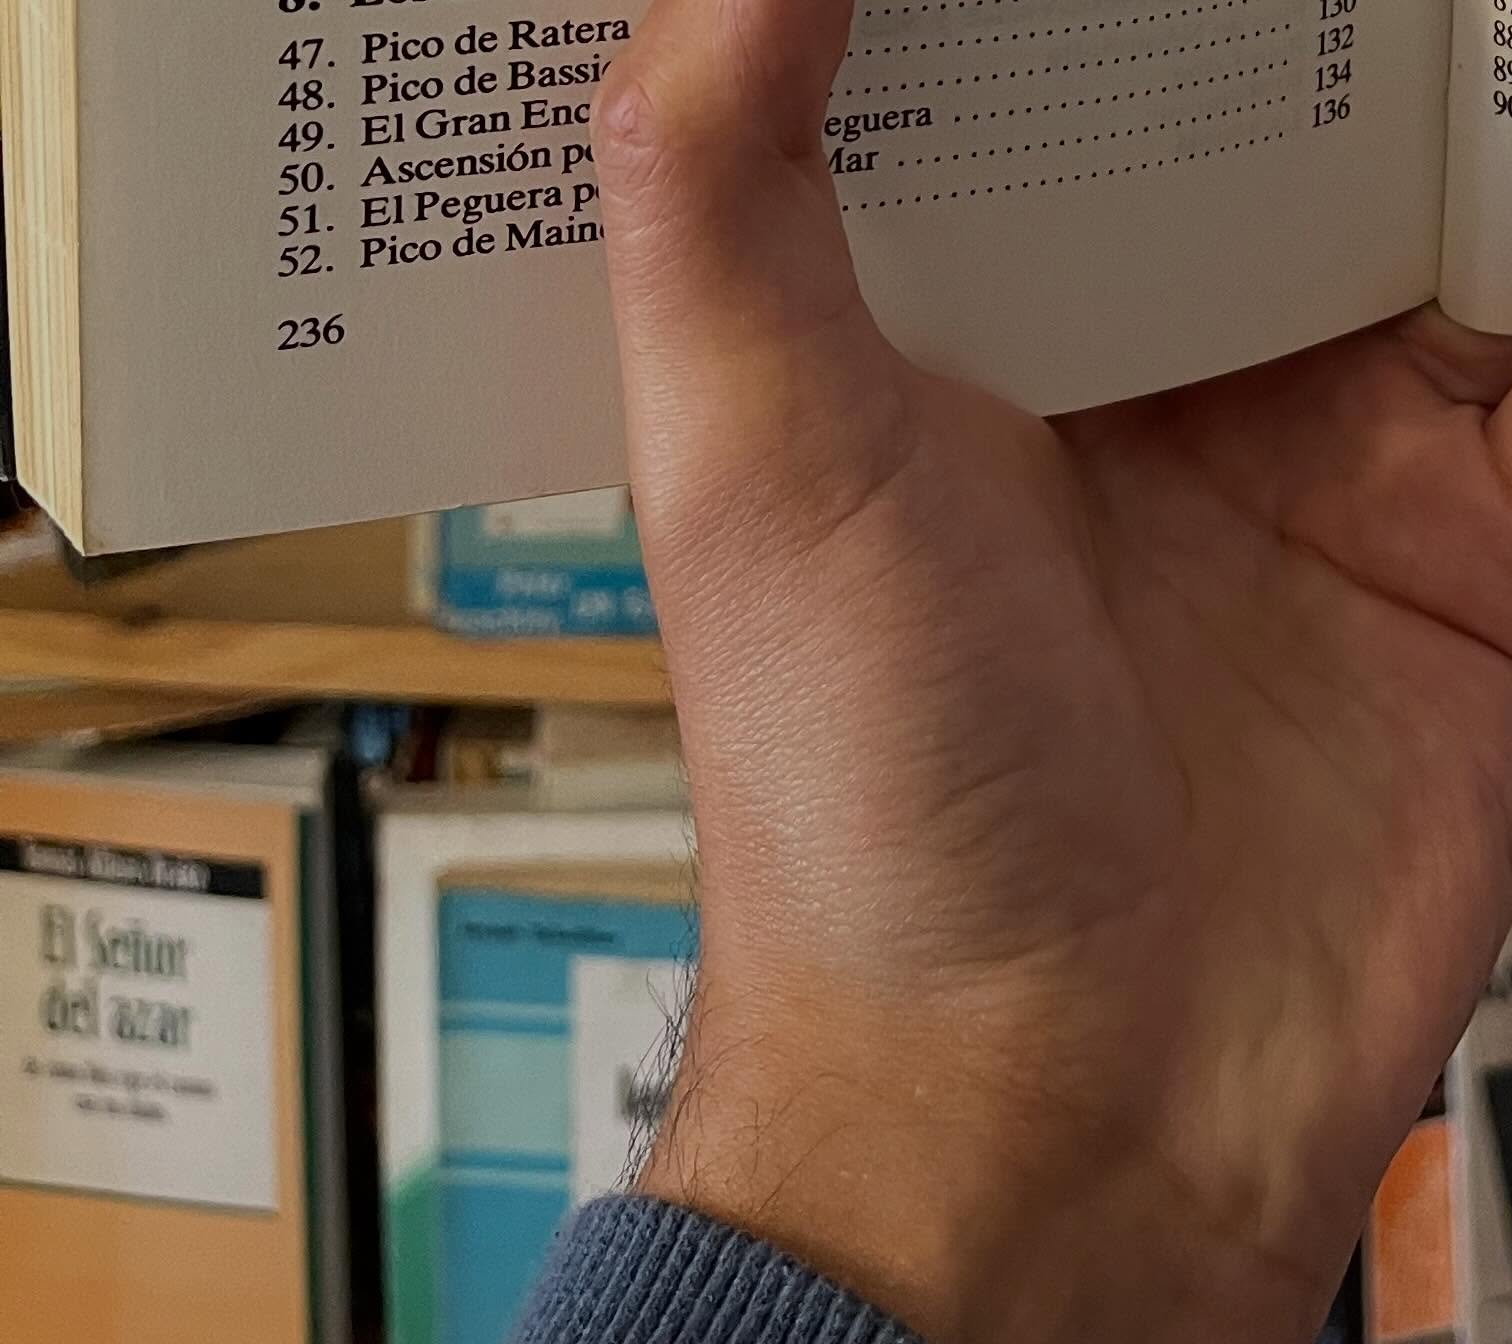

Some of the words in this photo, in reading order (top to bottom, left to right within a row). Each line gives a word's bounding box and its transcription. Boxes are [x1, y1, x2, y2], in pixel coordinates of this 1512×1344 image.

[278, 37, 336, 71] 47.
[360, 31, 445, 65] Pico
[454, 24, 499, 56] de
[507, 19, 632, 51] Ratera
[277, 313, 345, 351] 236
[42, 977, 98, 1036] del
